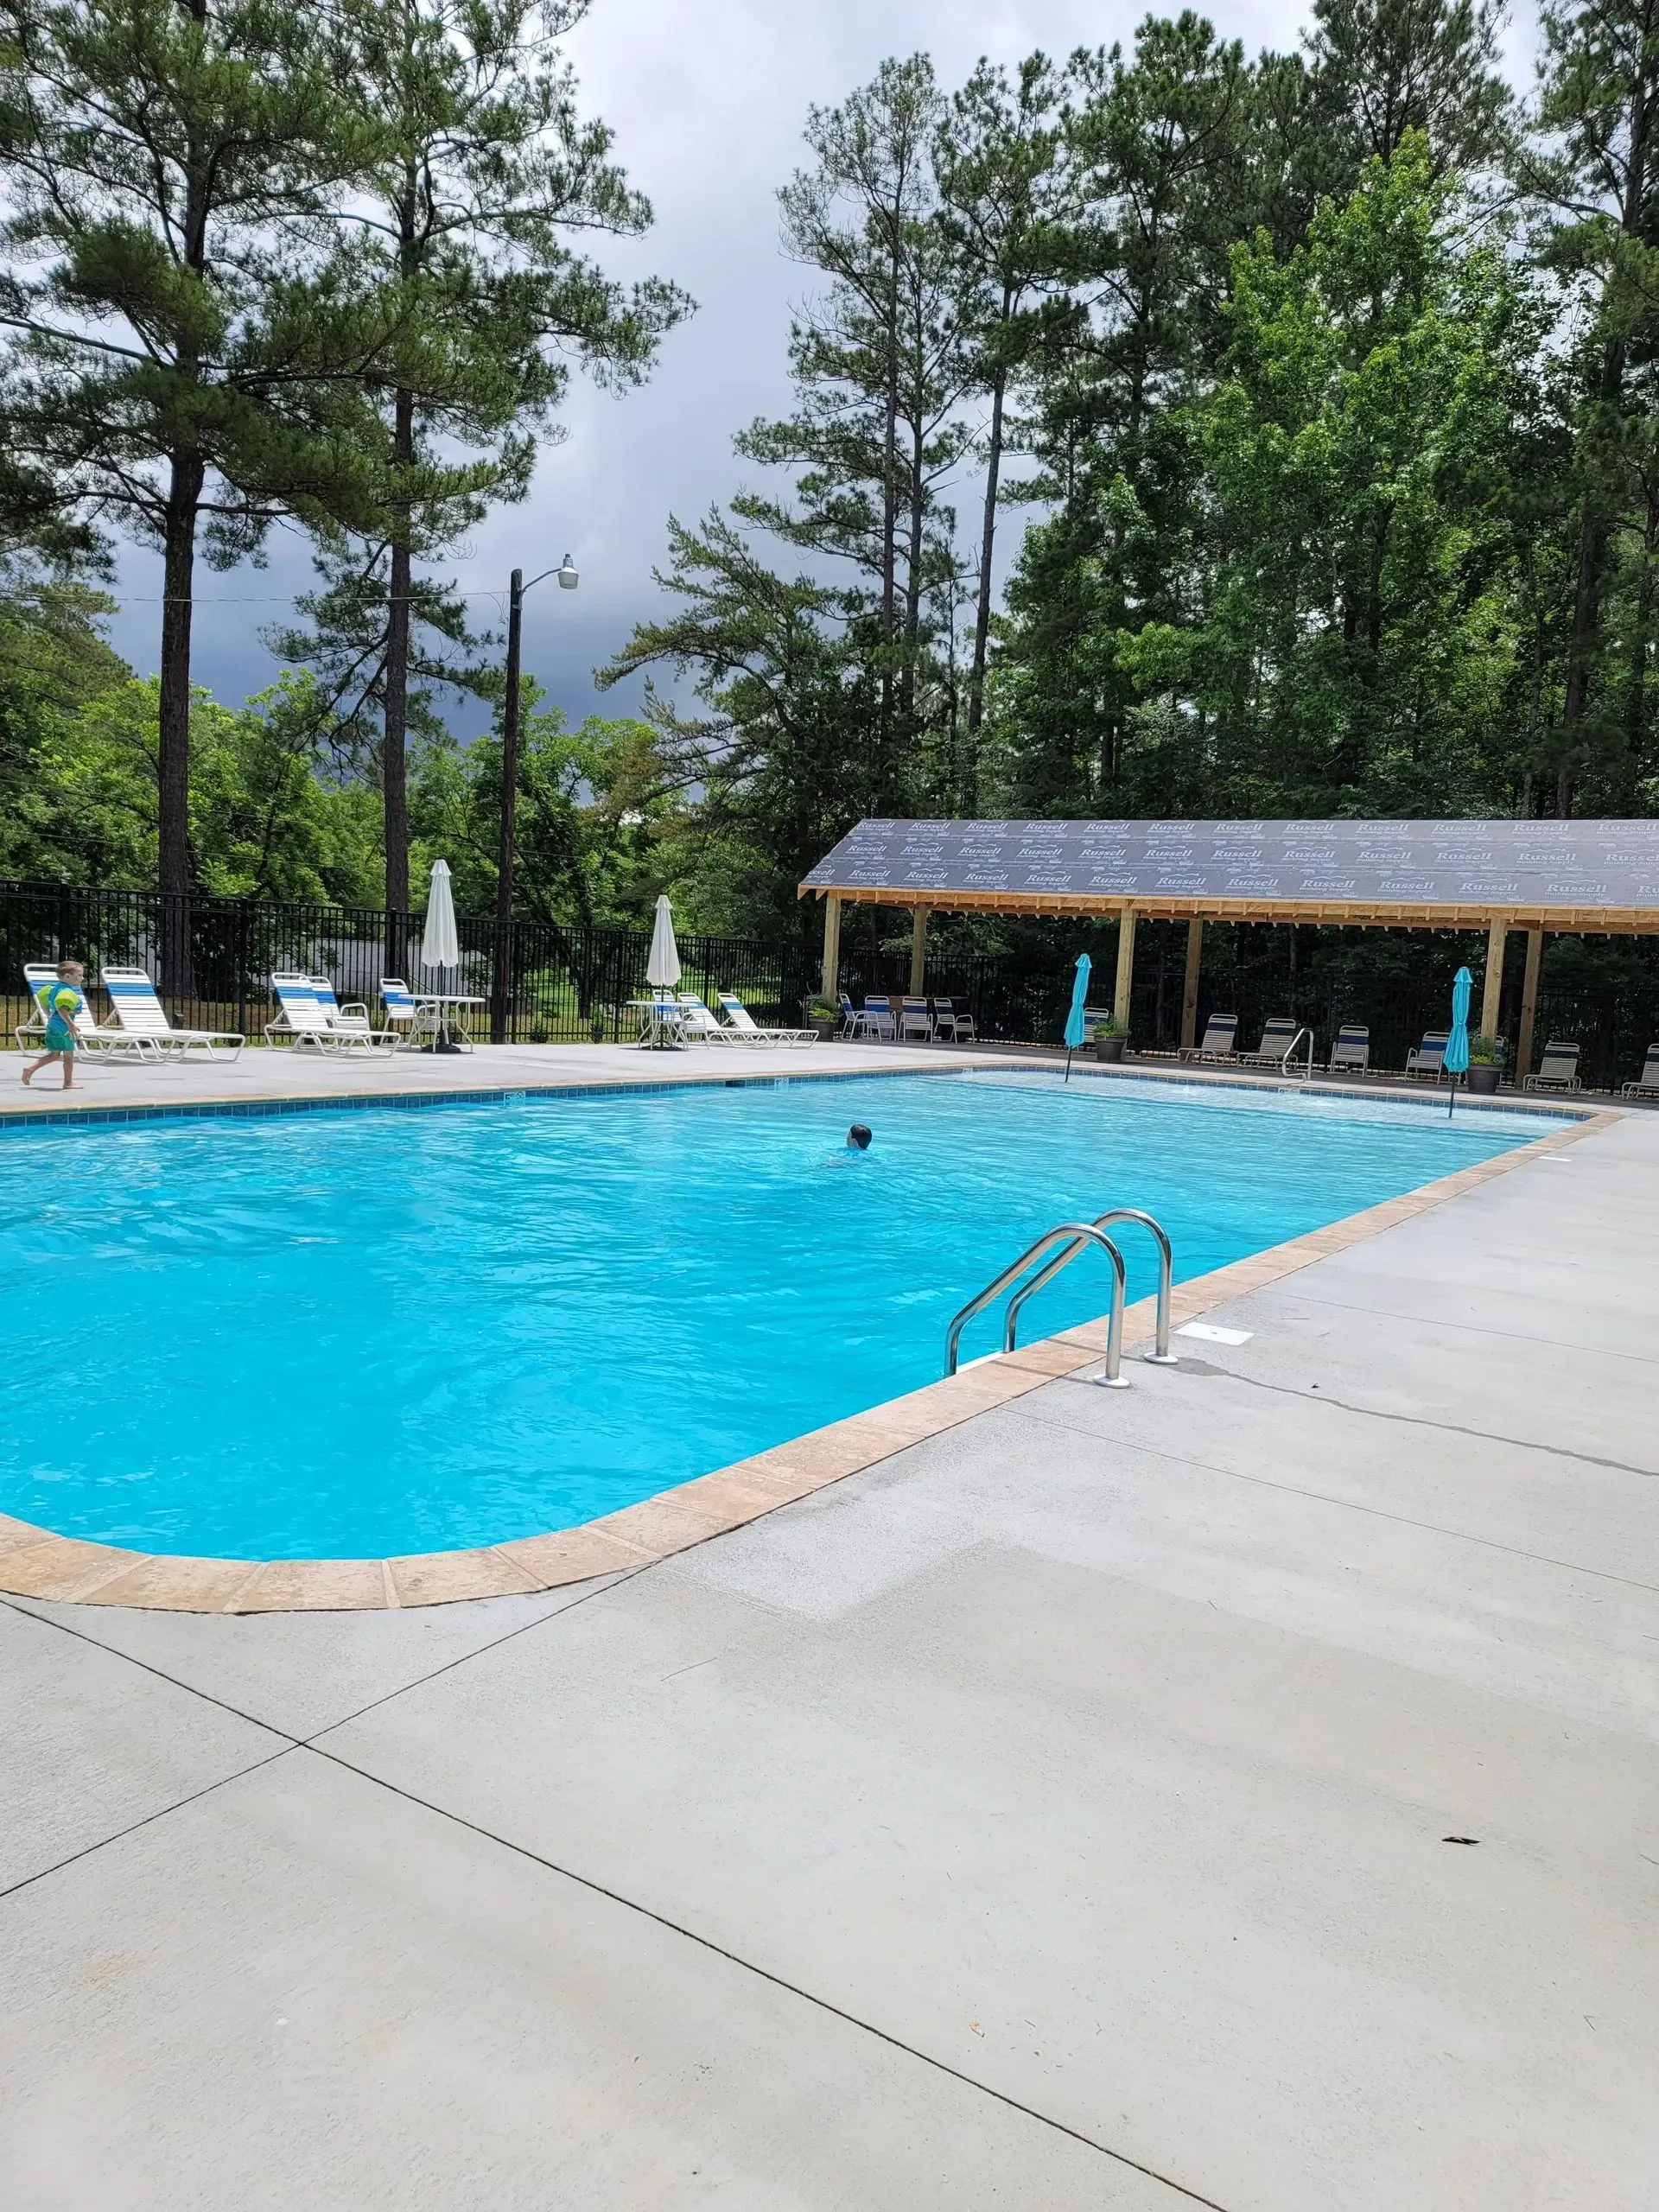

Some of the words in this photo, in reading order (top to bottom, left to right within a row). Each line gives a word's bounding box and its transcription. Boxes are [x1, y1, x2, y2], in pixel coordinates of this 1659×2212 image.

[1598, 823, 1657, 831] Russell
[1227, 878, 1279, 887] Russell
[1460, 882, 1518, 891] Russell
[1546, 884, 1607, 893] Russell
